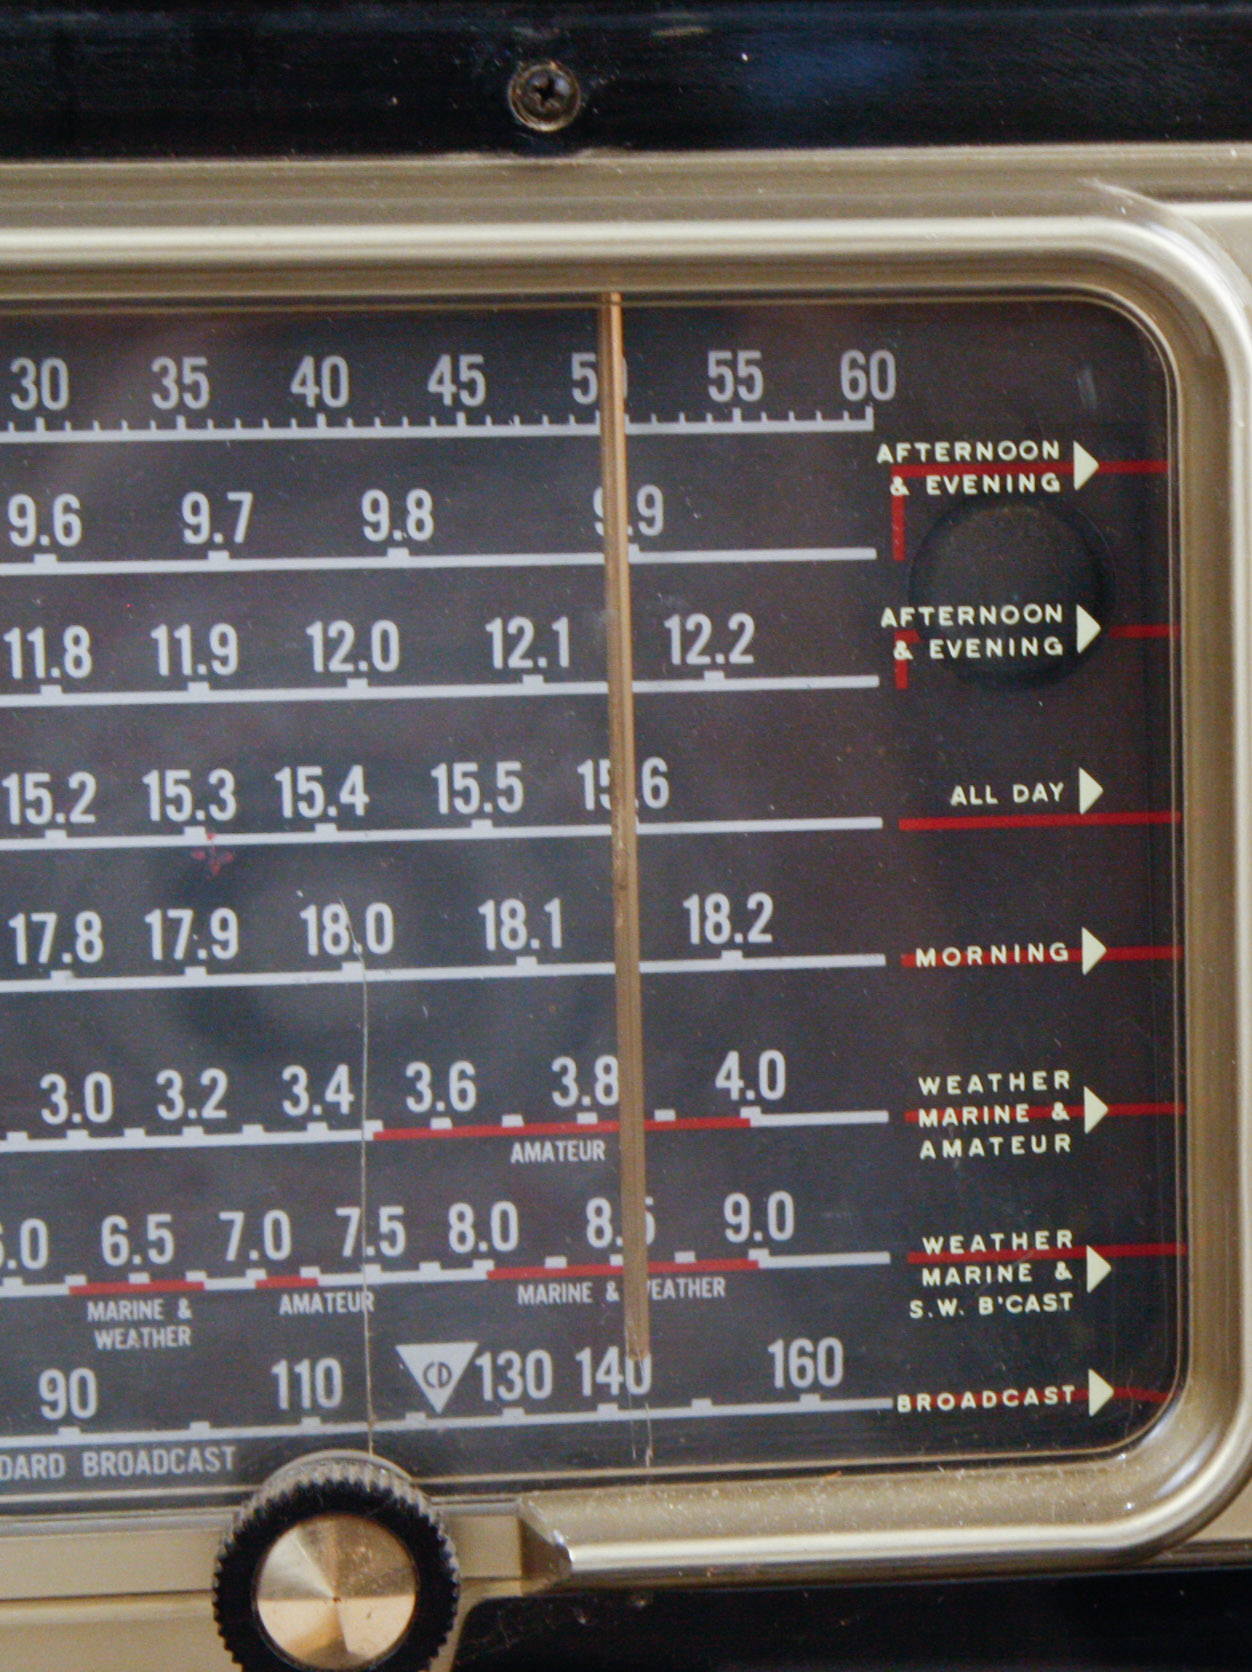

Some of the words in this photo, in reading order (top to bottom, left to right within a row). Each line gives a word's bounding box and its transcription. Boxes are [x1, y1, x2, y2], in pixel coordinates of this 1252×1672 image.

[10, 356, 70, 411] 30
[150, 355, 211, 410] 35
[290, 354, 350, 408] 40
[427, 353, 487, 406] 45
[570, 351, 628, 405] 5
[706, 349, 765, 403] 55
[839, 348, 898, 401] 60
[876, 438, 1062, 466] AFTERNOON
[889, 474, 910, 497] &
[924, 470, 1062, 497] EVENING
[7, 494, 82, 547] 9.6
[181, 491, 254, 544] 9.7
[360, 489, 434, 541] 9.8
[879, 602, 1064, 630] AFTERNOON
[3, 624, 92, 680] 11.8
[150, 623, 238, 677] 11.9
[304, 619, 400, 673] 12.0
[484, 616, 571, 670] 12.1
[664, 612, 756, 667] 12.2
[893, 639, 914, 661] &
[928, 634, 1065, 662] EVENING
[1, 770, 97, 826] 15.2
[142, 768, 238, 823] 15.3
[274, 764, 370, 819] 15.4
[430, 760, 525, 815] 15.5
[950, 784, 999, 806] ALL
[1012, 781, 1065, 803] DAY
[8, 910, 104, 966] 17.8
[144, 907, 239, 962] 17.9
[300, 902, 395, 958] 18.0
[477, 898, 563, 953] 18.1
[682, 892, 775, 946] 18.2
[914, 940, 1071, 968] MORNING
[38, 1070, 114, 1125] 3.0
[155, 1066, 229, 1121] 3.2
[280, 1063, 355, 1118] 3.4
[404, 1060, 477, 1112] 3.6
[550, 1055, 619, 1107] 3.8
[714, 1049, 788, 1101] 4.0
[917, 1068, 1071, 1097] WEATHER
[917, 1101, 1030, 1129] MARINE
[1051, 1100, 1071, 1122] &
[509, 1140, 606, 1164] AMATEUR
[918, 1132, 1072, 1162] AMATEUR
[0, 1217, 50, 1271] .0
[100, 1212, 176, 1268] 6.5
[217, 1208, 292, 1264] 7.0
[335, 1206, 406, 1258] 7.5
[446, 1200, 520, 1254] 8.0
[722, 1191, 796, 1244] 9.0
[921, 1228, 1074, 1257] WEATHER
[921, 1262, 1034, 1288] MARINE
[1054, 1260, 1074, 1281] &
[278, 1290, 375, 1316] AMATEUR
[516, 1280, 594, 1306] MARINE
[604, 1280, 620, 1303] &
[645, 1275, 726, 1301] EATHER
[908, 1298, 966, 1320] S.W.
[977, 1290, 1074, 1316] B'CAST
[86, 1300, 164, 1324] MARINE
[176, 1297, 193, 1321] &
[93, 1325, 193, 1351] WEATHER
[37, 1366, 99, 1421] 90
[270, 1356, 344, 1411] 110
[474, 1350, 554, 1402] 130
[574, 1345, 652, 1397] 140
[766, 1337, 844, 1389] 160
[897, 1384, 1075, 1414] BROADCAST
[82, 1445, 237, 1478] BROADCAST
